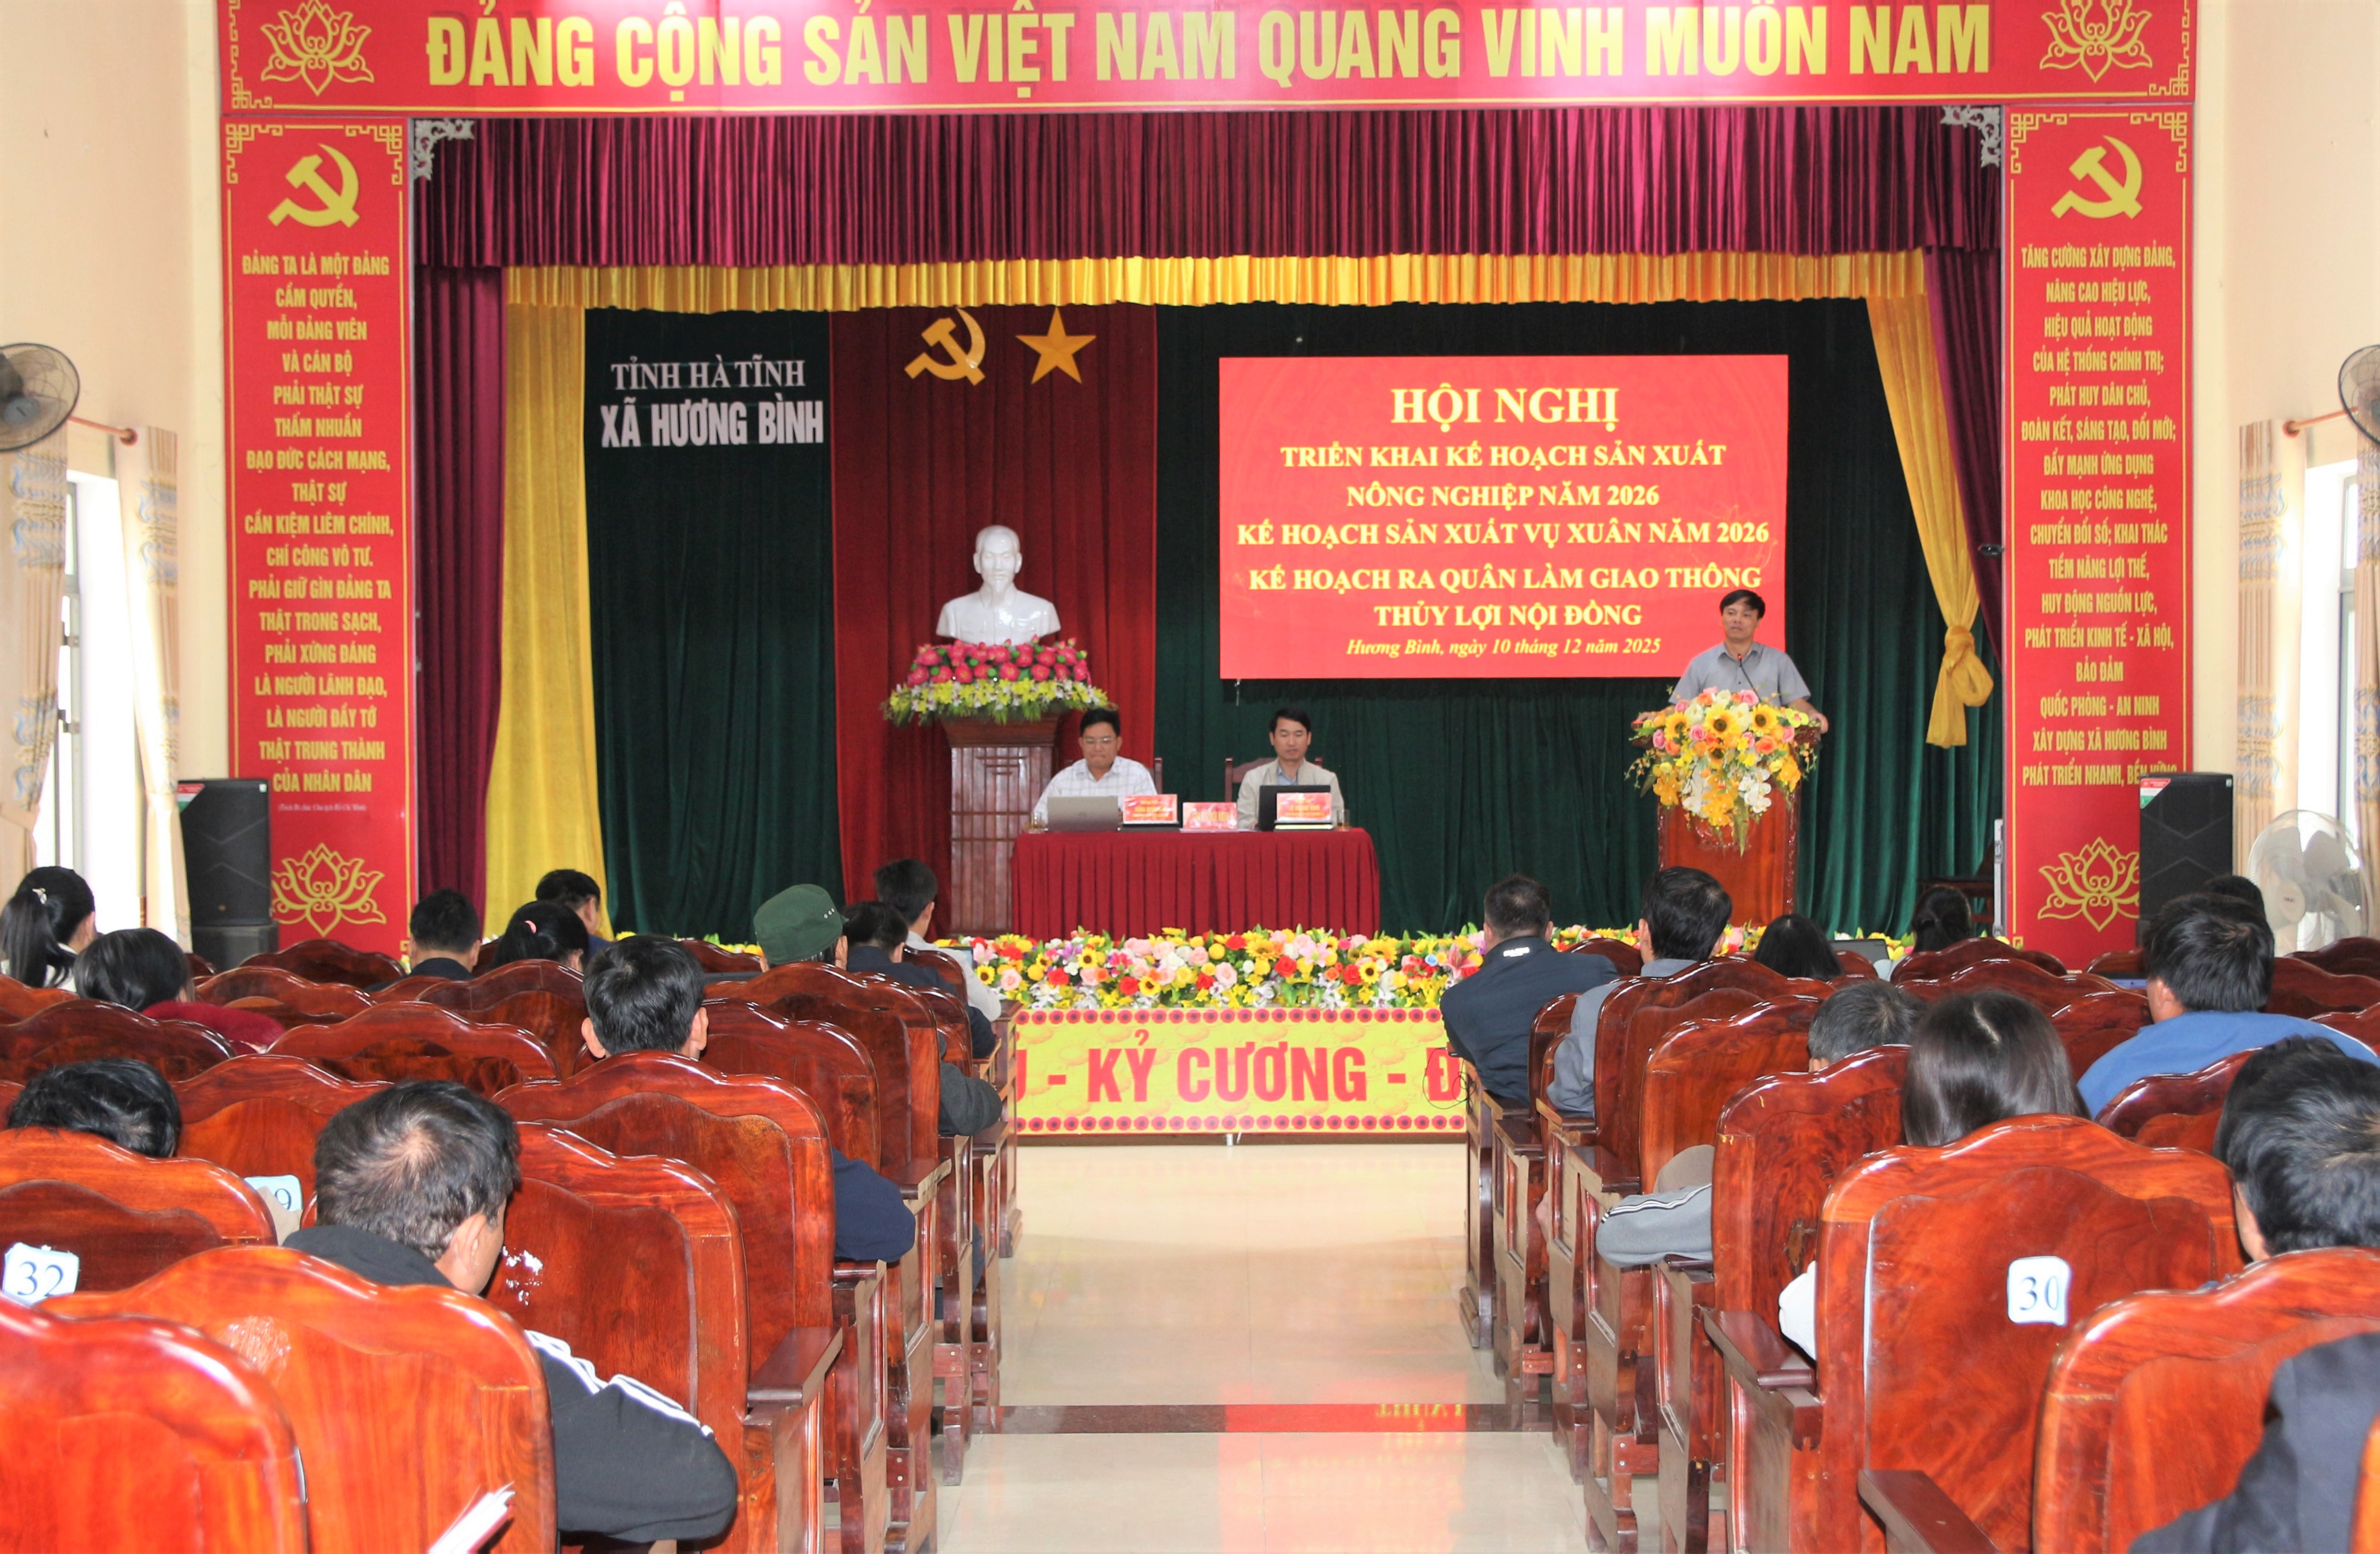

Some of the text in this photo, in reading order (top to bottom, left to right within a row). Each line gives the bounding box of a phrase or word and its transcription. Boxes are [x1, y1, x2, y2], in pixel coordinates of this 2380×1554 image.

[427, 0, 594, 86] ĐẢNG
[616, 1, 782, 102] CỘNG
[803, 0, 928, 86] SẢN
[947, 0, 1075, 98] VIỆT
[1096, 12, 1236, 81] NAM
[1258, 6, 1462, 88] QUANG
[1482, 7, 1624, 79] VINH
[282, 255, 299, 275] TA
[300, 253, 319, 276] LÀ
[320, 251, 351, 279] MỘT
[2089, 243, 2111, 268] XÂY
[2046, 278, 2075, 303] NÂNG
[2078, 282, 2099, 302] CAO
[2102, 280, 2125, 306] HIỆU
[335, 317, 368, 341] VIÊN
[2043, 313, 2070, 341] HIỆU
[2093, 315, 2123, 341] HOẠT
[2123, 312, 2154, 341] ĐỘNG
[281, 349, 354, 376] VÀ CÁN BỘ
[611, 353, 806, 390] TỈNH HÀ TĨNH
[2056, 347, 2071, 375] HỆ
[2108, 349, 2144, 372] CHÍNH
[307, 381, 342, 409] THẬT
[1390, 381, 1619, 433] HỘI NGHỊ
[2048, 381, 2125, 407] PHÁT HUY DÂN
[600, 392, 824, 448] XÃ HƯƠNG BÌNH
[2020, 418, 2051, 442] ĐOÀN
[2075, 418, 2106, 441] SÁNG
[245, 449, 275, 473] ĐẠO
[306, 447, 345, 470] CÁCH
[1370, 446, 1439, 467] KHAI
[1445, 439, 1483, 467] KẾ
[1489, 445, 1588, 472] HOẠCH
[1593, 439, 1646, 467] SẢN
[1652, 438, 1727, 466] XUẤT
[2065, 453, 2155, 480] MẠNH DỤNG
[291, 479, 326, 506] THẬT
[1346, 480, 1660, 512] NÔNG NGHIỆP NĂM 2026
[2040, 489, 2070, 511] KHOA
[2070, 489, 2094, 514] HỌC
[2093, 485, 2125, 510] CÔNG
[275, 511, 311, 538] KIỆM
[312, 511, 347, 535] LIÊM
[1237, 516, 1771, 550] KẾ HOẠCH SẢN XUẤT VỤ XUÂN NĂM 2026
[2113, 520, 2169, 544] KHAI THÁC
[265, 544, 290, 567] CHÍ
[291, 543, 330, 567] CÔNG
[332, 544, 351, 567] VÔ
[376, 579, 393, 599] TA
[1249, 561, 1763, 595] KẾ HOẠCH RA QUÂN LÀM GIAO THÔNG
[1373, 599, 1643, 631] THỦY LỢI NỘI ĐỒNG
[2041, 593, 2063, 614] HUY
[2063, 589, 2095, 616] ĐỘNG
[259, 608, 293, 635] THẬT
[294, 611, 340, 632] TRONG
[1346, 637, 1661, 658] Hương Bình, ngày 10 tháng 12 năm 2025
[2024, 626, 2054, 649] PHÁT
[2086, 626, 2114, 648] KINH
[338, 641, 378, 664] ĐÁNG
[254, 674, 273, 697] LÀ
[266, 706, 285, 729] LÀ
[2116, 694, 2161, 716] AN NINH
[258, 736, 386, 764] THẬT TRUNG THÀNH
[2032, 727, 2054, 752] XÂY
[2103, 729, 2141, 751] HƯƠNG
[302, 769, 343, 792] NHÂN
[343, 769, 373, 793] DÂN
[2021, 762, 2050, 786] PHÁT
[1088, 1029, 1157, 1102] KỶ
[1176, 1042, 1367, 1102] CƯƠNG
[17, 1260, 65, 1297] 32
[2019, 1276, 2060, 1311] 30
